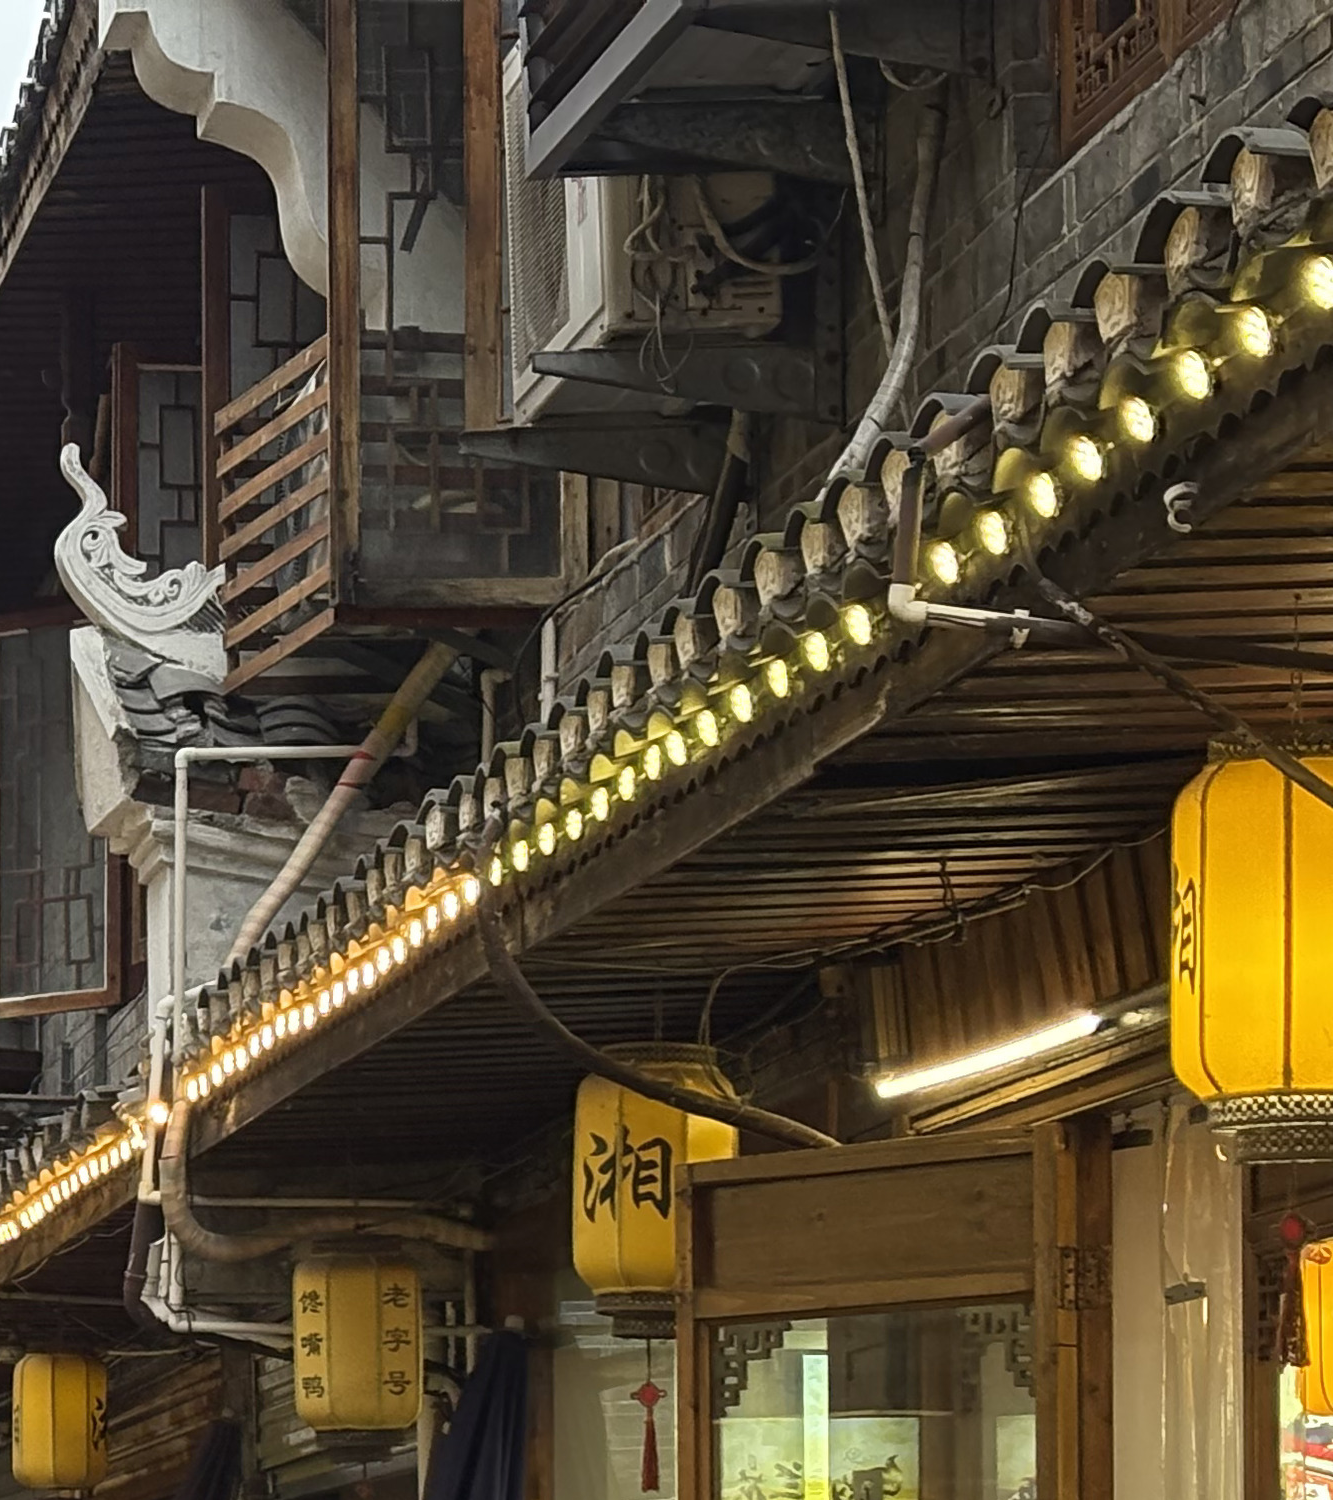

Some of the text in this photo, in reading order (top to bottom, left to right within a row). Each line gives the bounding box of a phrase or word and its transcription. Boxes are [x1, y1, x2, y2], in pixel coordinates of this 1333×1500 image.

[582, 1122, 673, 1223] 湘
[298, 1289, 325, 1399] 馋嘴鸭
[383, 1283, 412, 1396] 老字号
